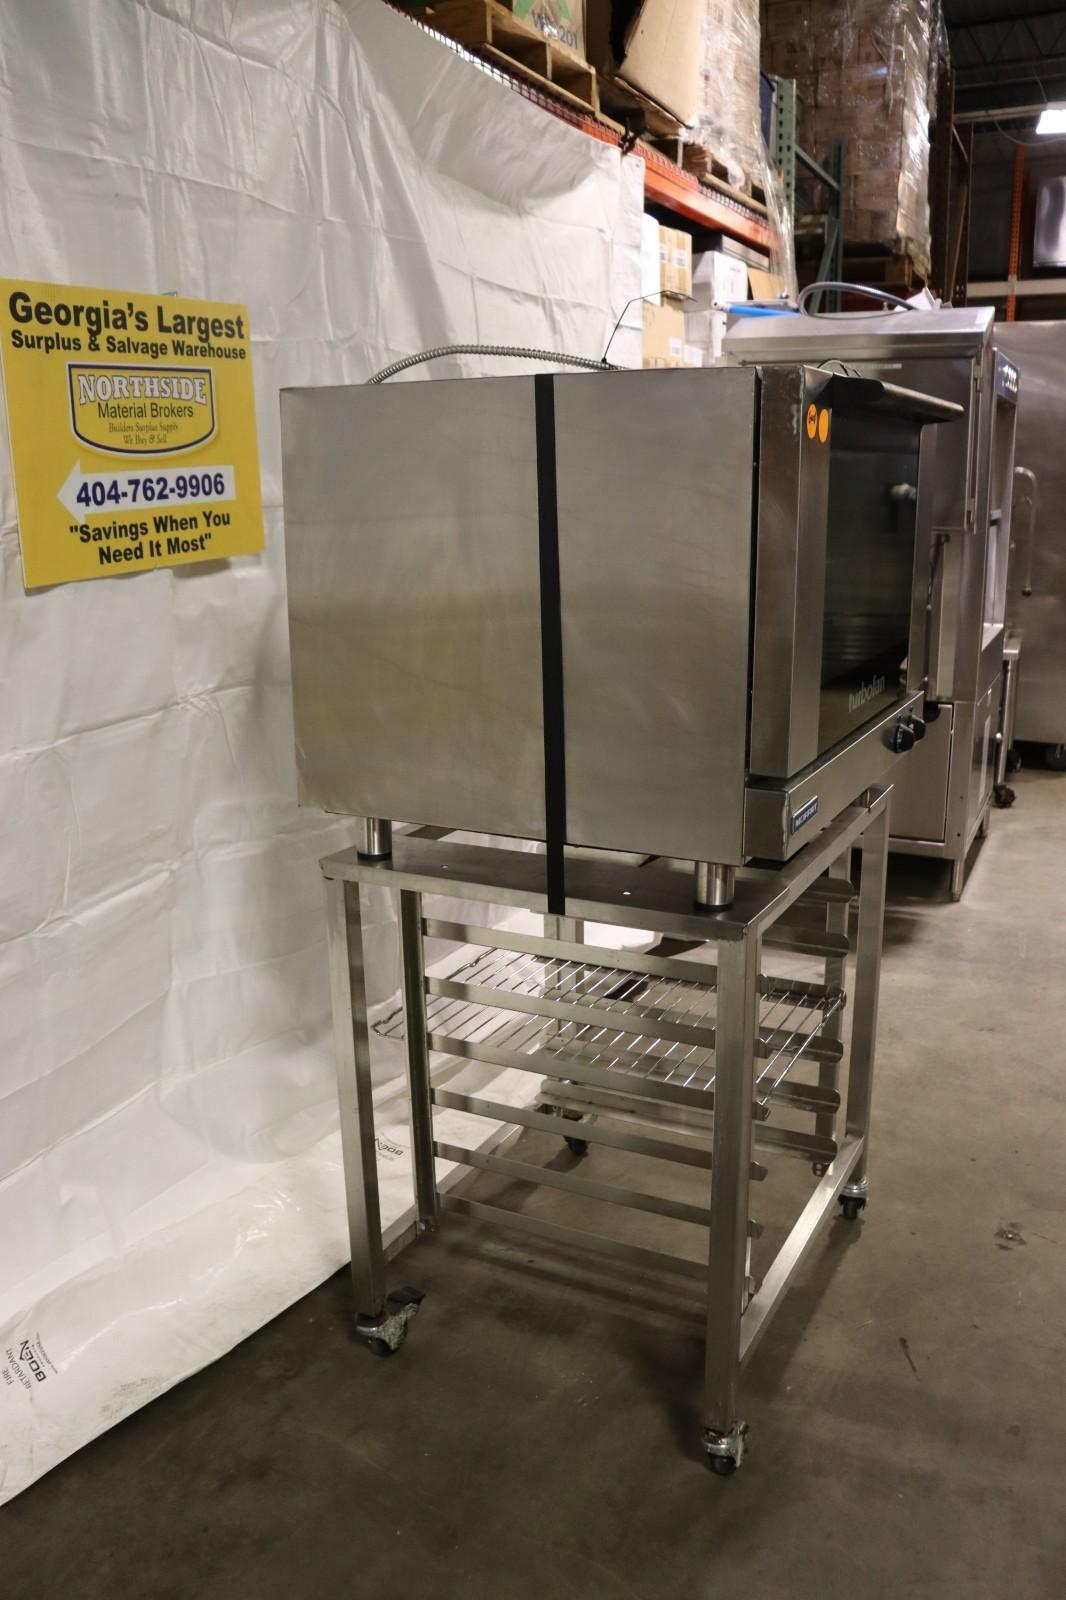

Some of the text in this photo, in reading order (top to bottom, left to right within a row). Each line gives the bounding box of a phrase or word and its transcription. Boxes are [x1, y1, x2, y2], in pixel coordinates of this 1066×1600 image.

[9, 291, 245, 343] Georgia's Largest
[11, 329, 246, 360] Surplus & Salvage Warehouse
[77, 374, 208, 406] NORTHSIDE
[98, 402, 194, 419] Material Brokers
[109, 422, 179, 435] Builders Surplus Supply
[123, 434, 134, 444] We
[135, 434, 148, 447] Buy
[157, 434, 168, 444] Sell
[76, 472, 225, 507] 404-762-9906
[69, 510, 231, 544] "Savings When You
[99, 533, 212, 565] Need It Most"
[1, 1368, 14, 1386] FIRE
[5, 1348, 32, 1391] RETARDANT
[19, 1339, 47, 1383] BOEN
